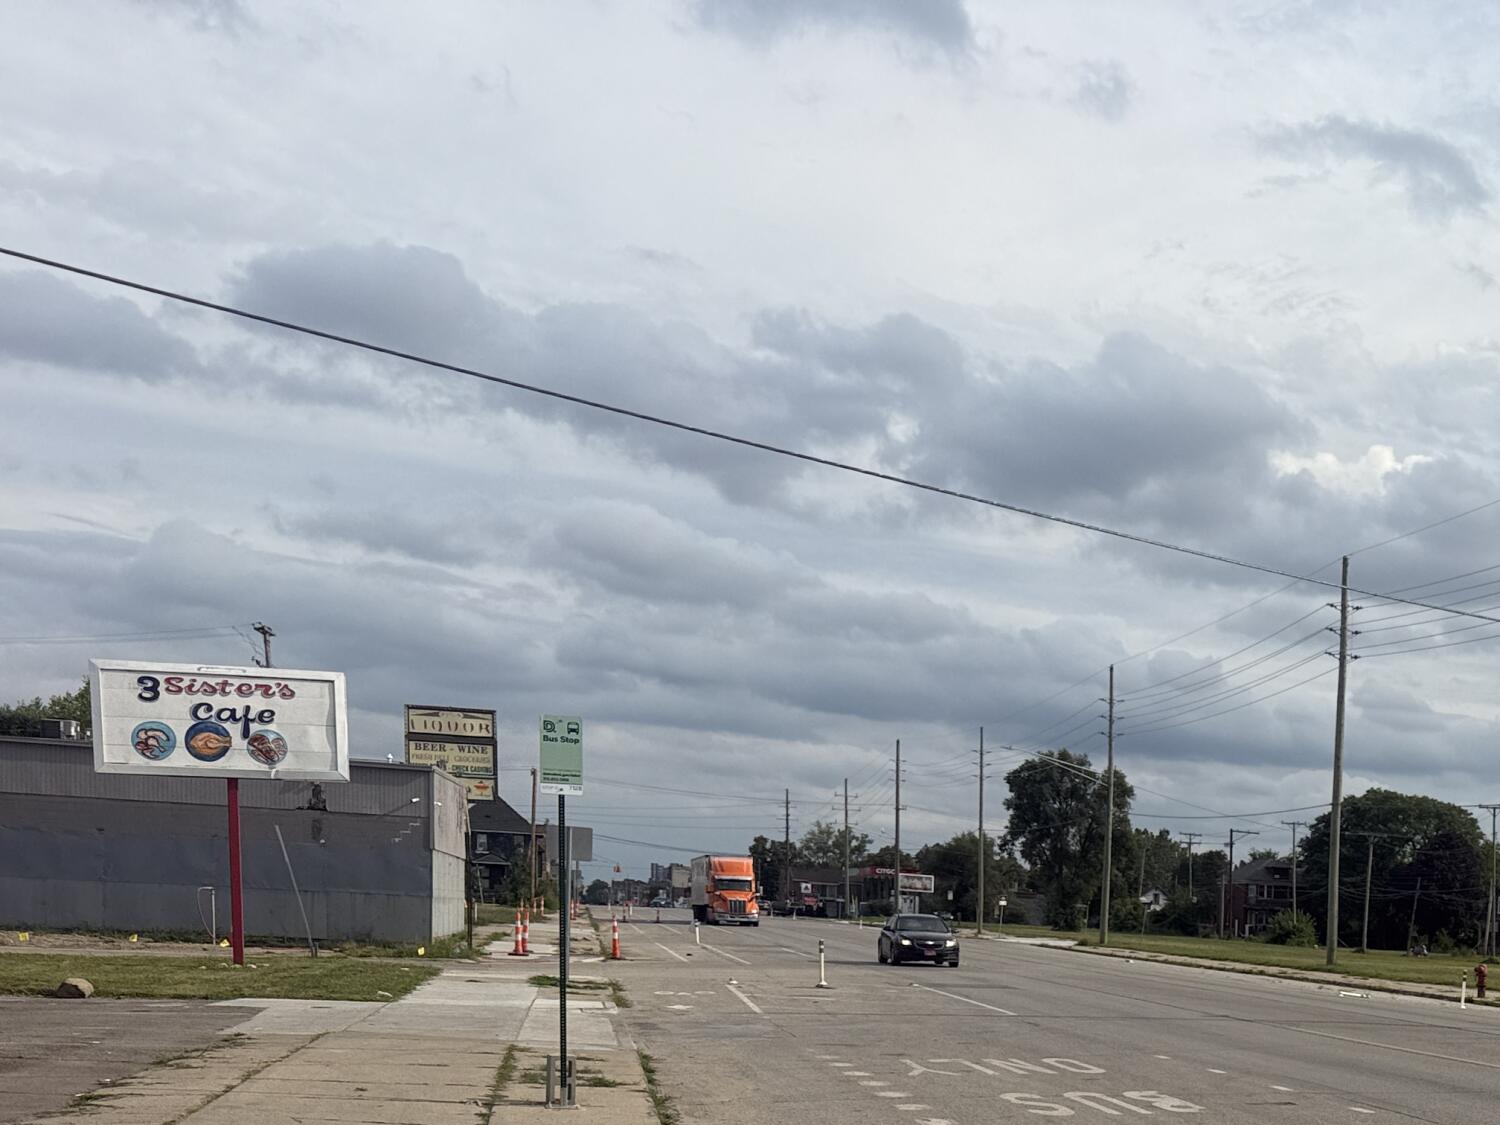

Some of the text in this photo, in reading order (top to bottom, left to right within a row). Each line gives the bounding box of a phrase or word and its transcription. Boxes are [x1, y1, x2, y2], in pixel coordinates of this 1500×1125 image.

[137, 676, 296, 702] 3 Sister's
[190, 702, 277, 740] Cafe
[415, 742, 447, 753] BEER
[457, 744, 489, 755] WINE
[542, 734, 580, 745] Bus Stop
[900, 1057, 1107, 1076] ONLY
[999, 1090, 1206, 1116] BUS
